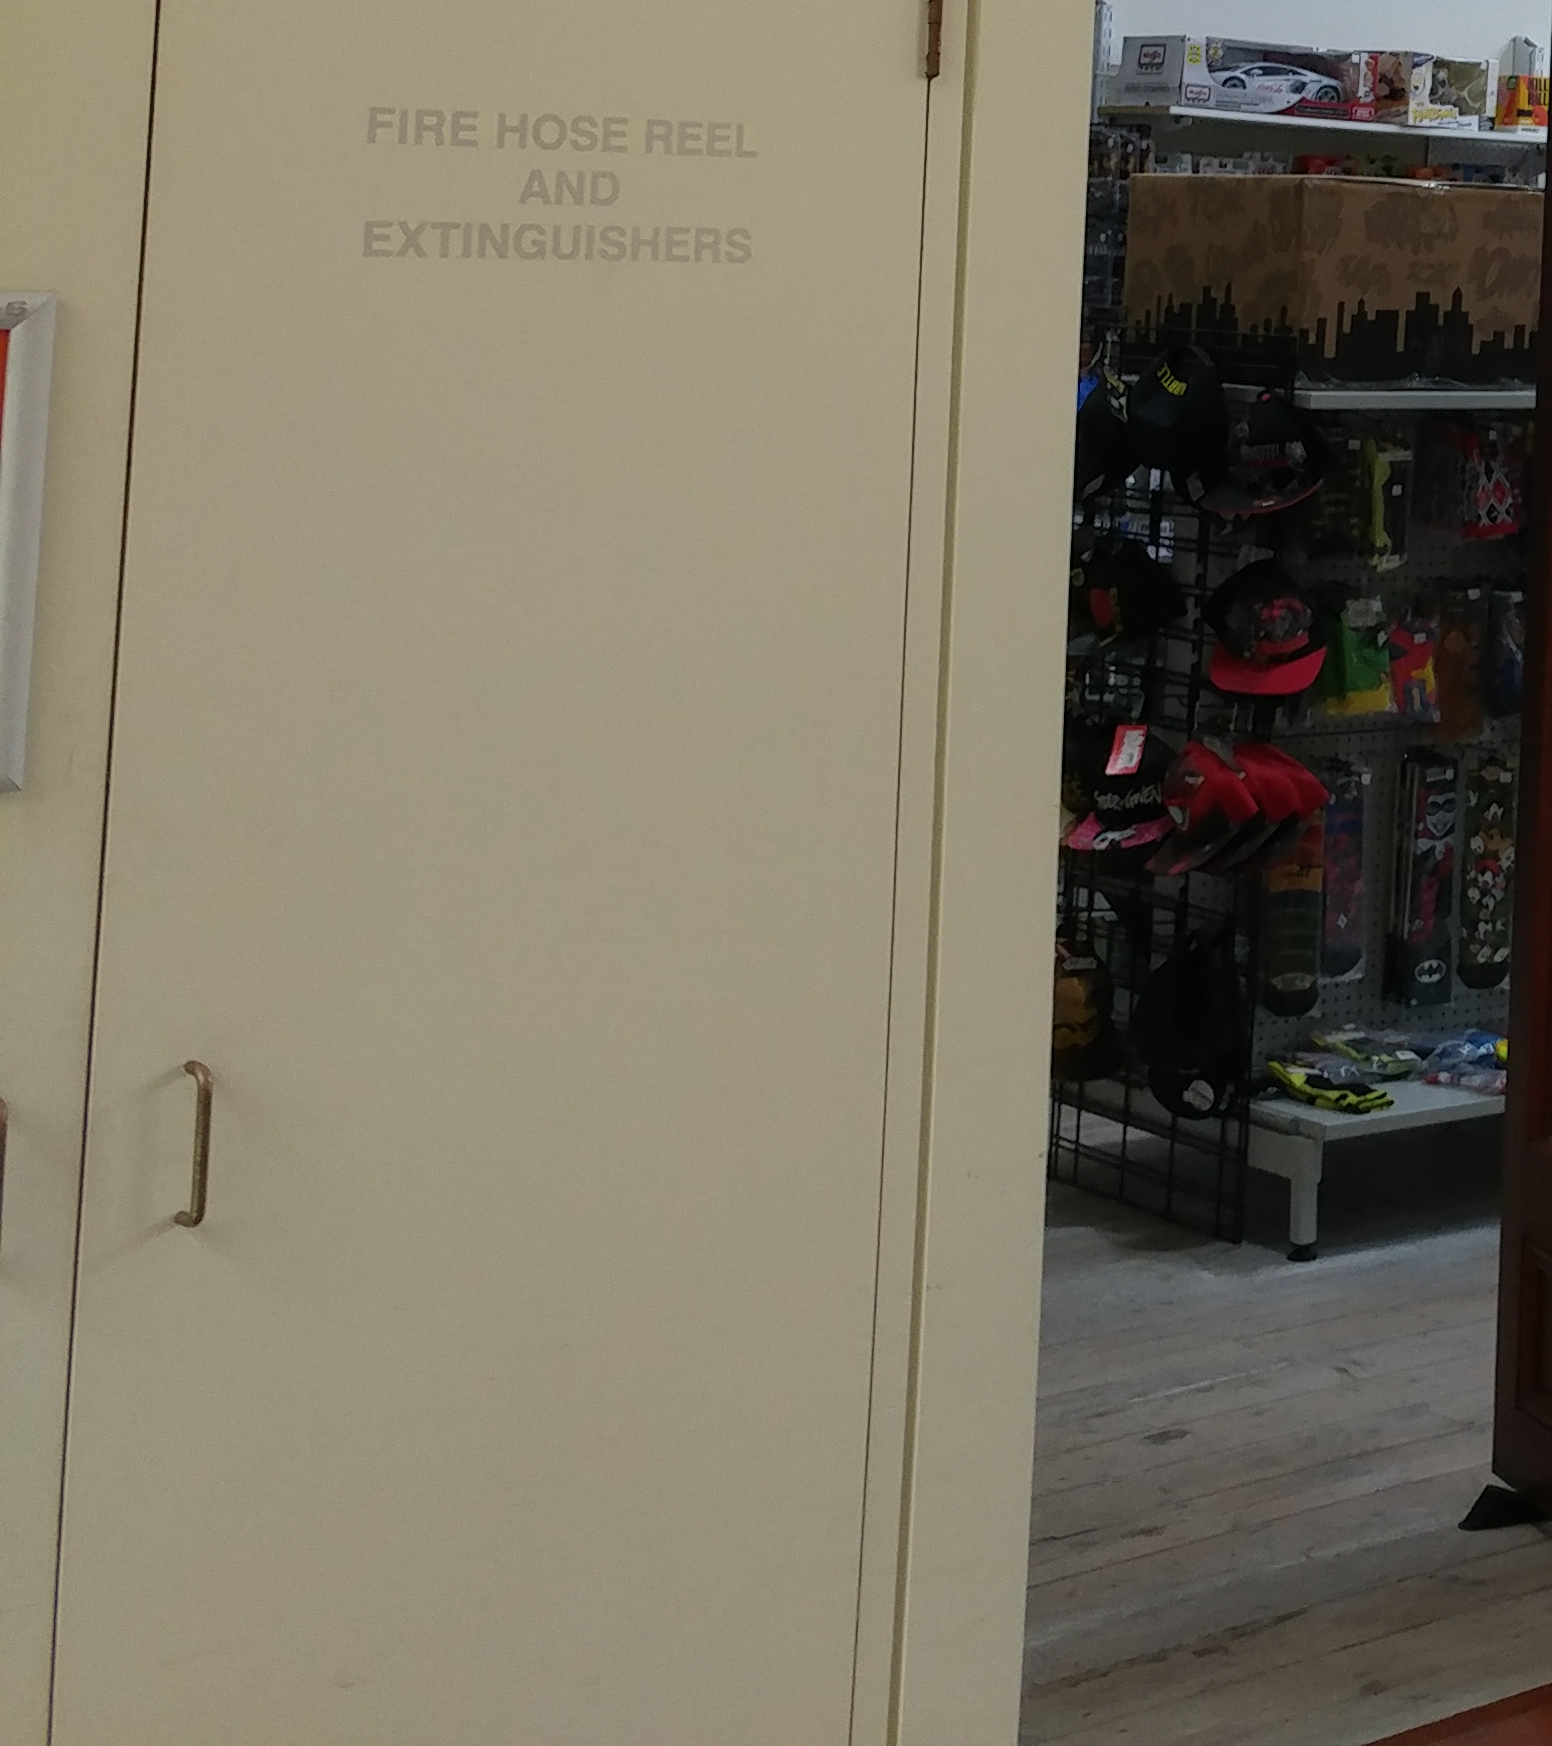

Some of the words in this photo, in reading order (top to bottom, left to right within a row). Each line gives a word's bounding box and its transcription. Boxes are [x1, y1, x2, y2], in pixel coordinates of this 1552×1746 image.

[367, 106, 479, 147] FIRE
[496, 112, 629, 153] HOSE
[644, 117, 758, 158] REEL
[518, 169, 621, 206] AND
[363, 220, 753, 264] EXTINGUISHERS
